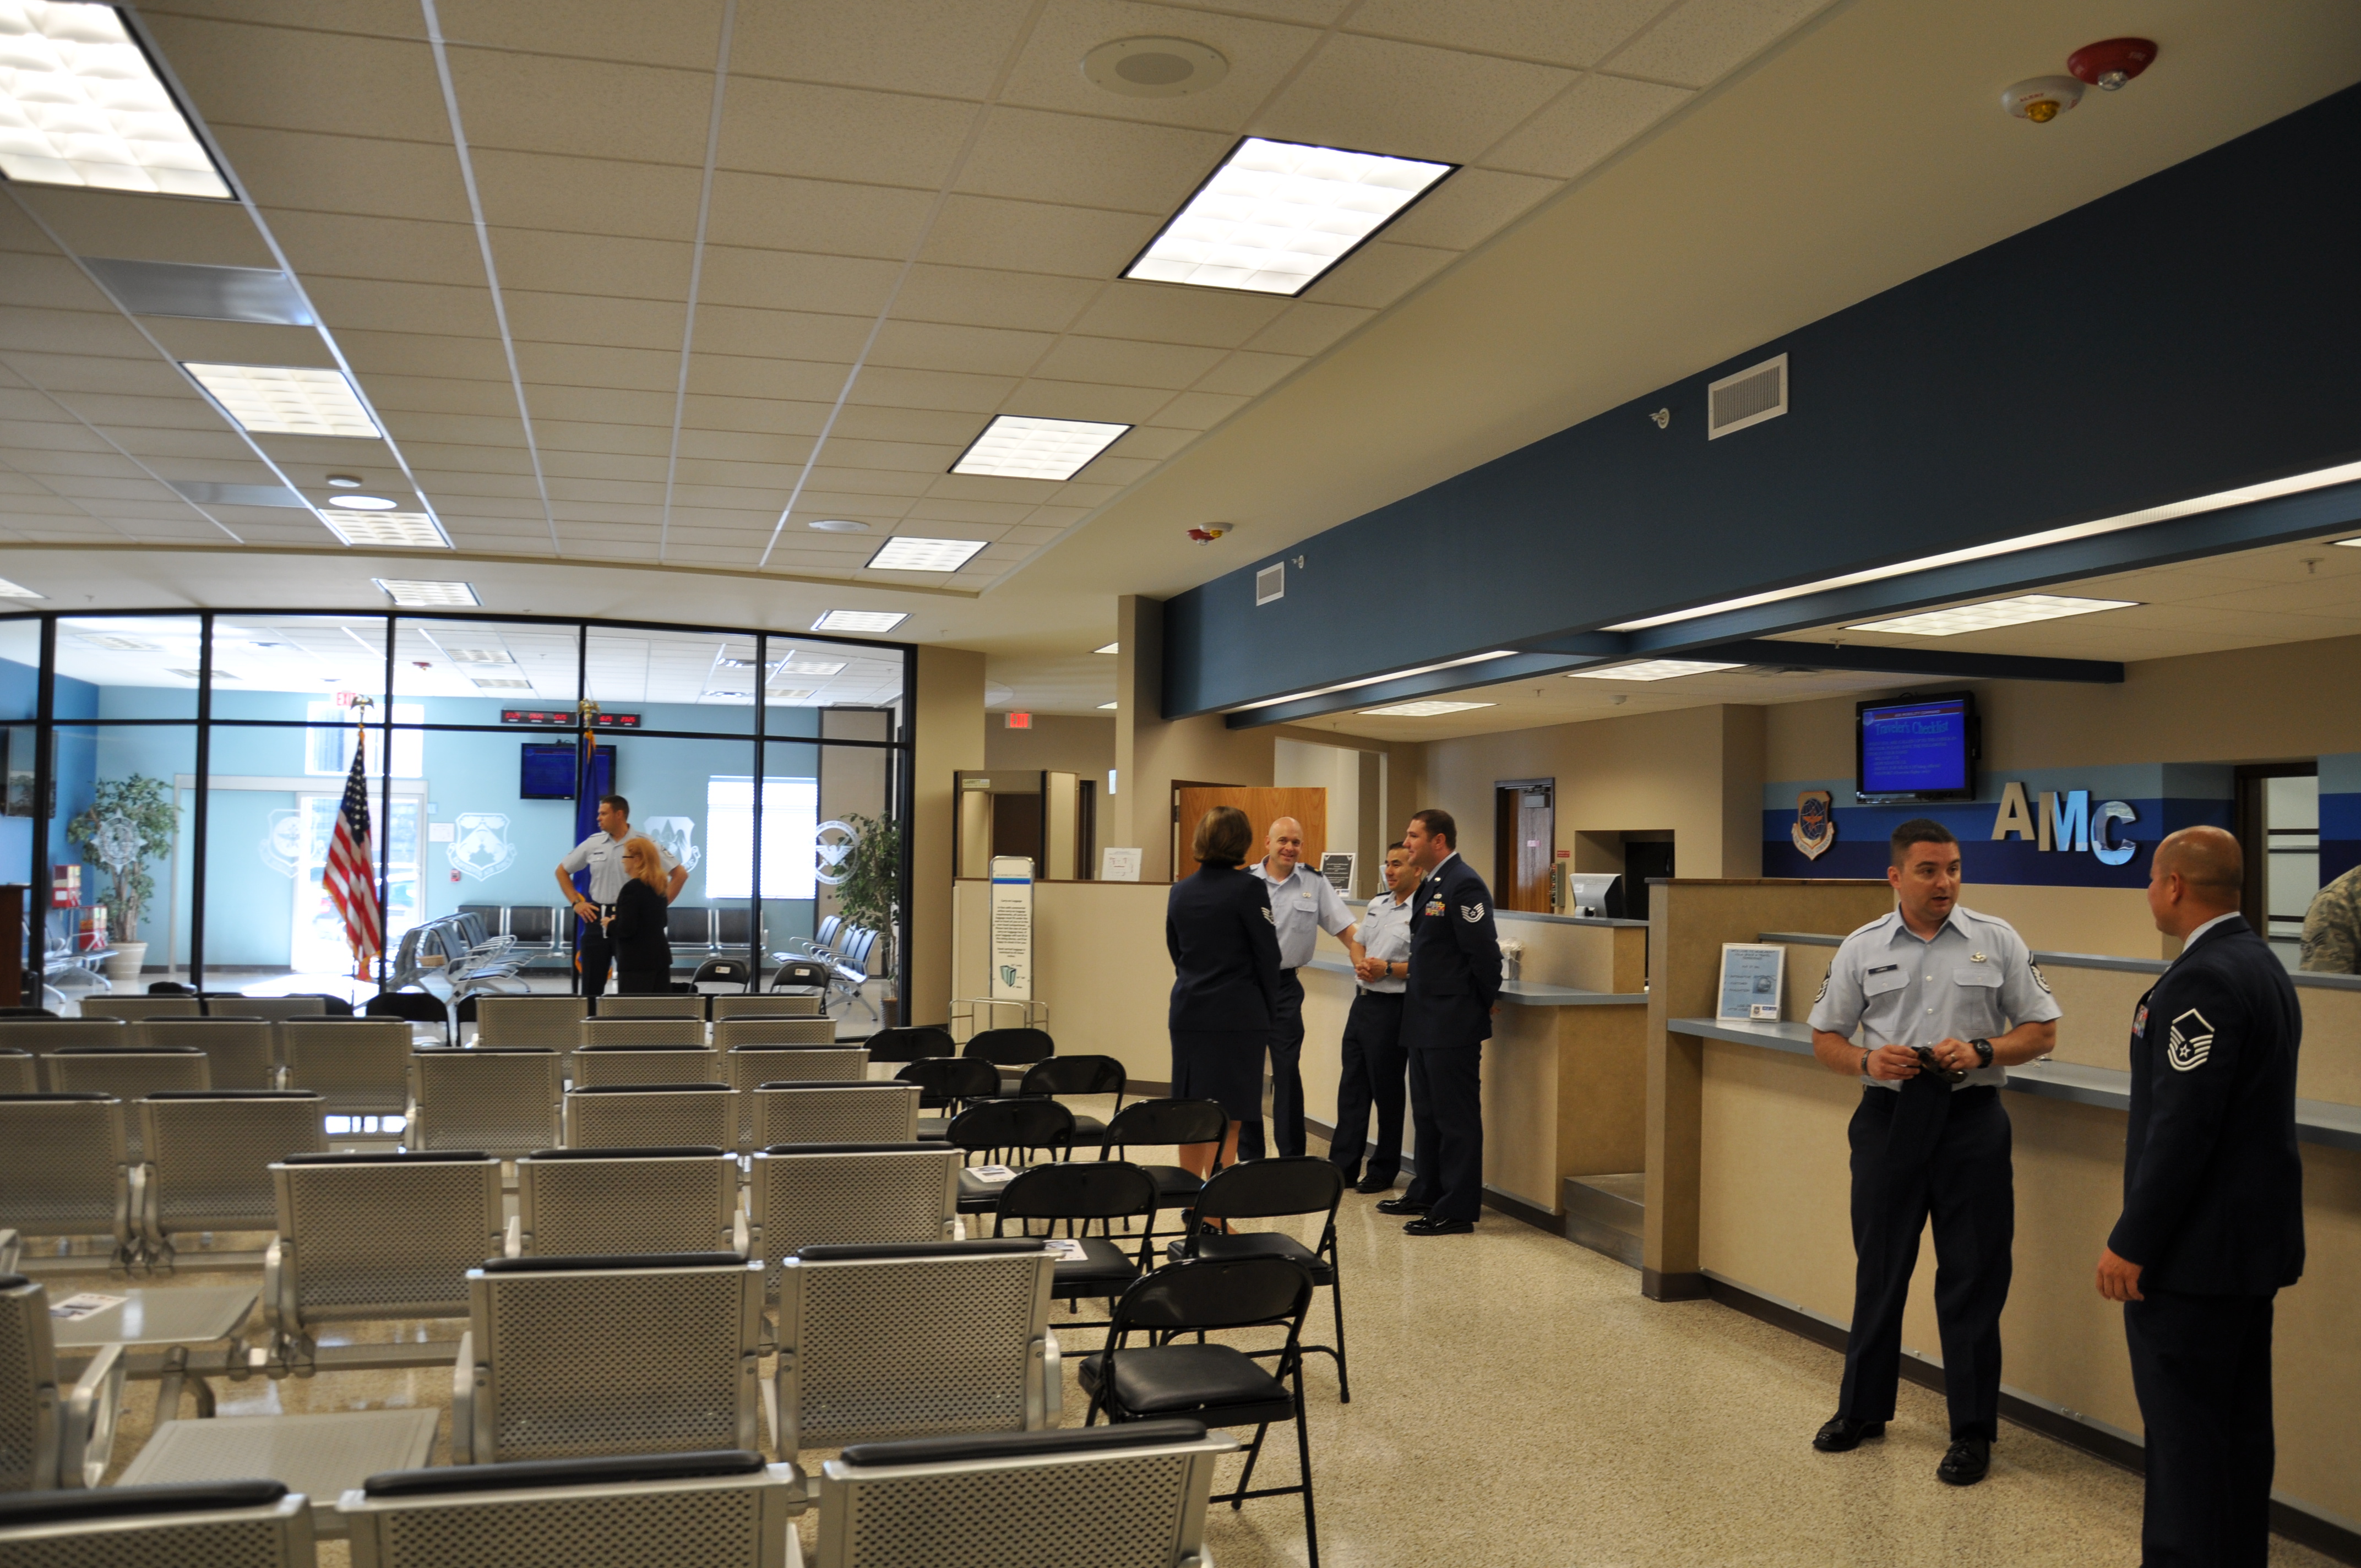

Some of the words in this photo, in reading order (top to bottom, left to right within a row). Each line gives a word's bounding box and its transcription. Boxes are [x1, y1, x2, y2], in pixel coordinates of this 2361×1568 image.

[1010, 713, 1029, 728] EXIT
[1875, 721, 1910, 736] Traveler's
[1912, 720, 1948, 734] Checklist
[1991, 781, 2137, 865] AMC
